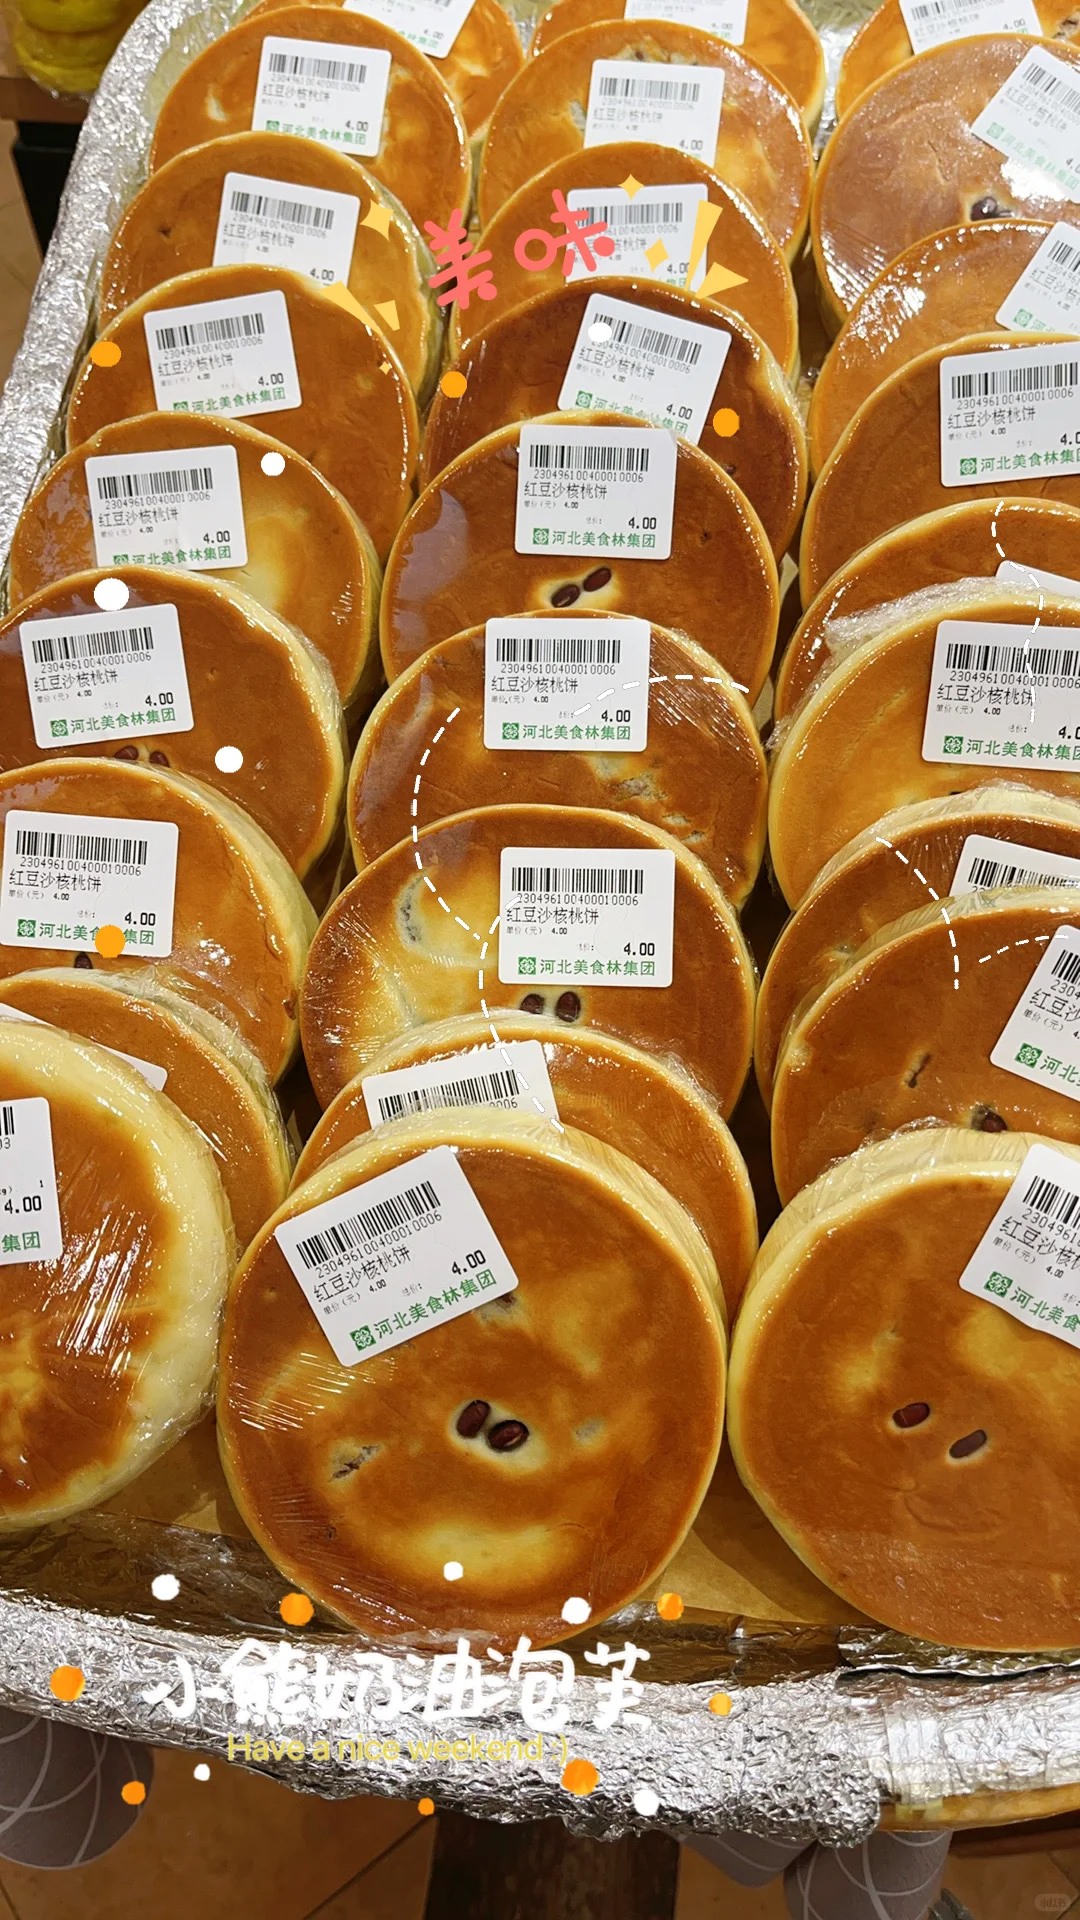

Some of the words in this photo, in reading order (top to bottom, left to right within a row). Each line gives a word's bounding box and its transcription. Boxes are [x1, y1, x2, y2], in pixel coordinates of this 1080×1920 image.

[345, 120, 369, 133] 4.00
[679, 139, 704, 151] 4.00
[310, 268, 334, 281] 4.00
[258, 373, 284, 387] 4.00
[192, 387, 286, 413] 河北美食林集团
[666, 404, 693, 420] 4.00
[534, 469, 644, 482] 230496100400010006
[524, 481, 608, 500] 红豆沙核桃饼
[139, 526, 154, 534] 4.00
[628, 517, 657, 529] 4.00
[203, 530, 230, 544] 4.00
[552, 530, 656, 548] 河北美食林集团
[132, 545, 231, 565] 河北美食林集团
[501, 663, 616, 675] 230496100400010006
[34, 668, 118, 692] 红豆沙核桃饼
[491, 676, 578, 693] 红豆沙核桃饼
[77, 690, 92, 698] 4.00
[145, 692, 174, 706] 4.00
[601, 709, 631, 722] 4.00
[983, 707, 1001, 715] 4.00
[71, 708, 176, 733] 河北美食林集团
[522, 724, 631, 740] 河北美食林集团
[20, 856, 141, 876] 230496100400010006
[9, 869, 101, 893] 红豆沙核桃饼
[53, 893, 69, 901] 4.00
[125, 912, 156, 926] 4.00
[506, 906, 599, 925] 红豆沙核桃饼
[551, 927, 567, 935] 4.00
[624, 942, 655, 956] 4.00
[540, 959, 655, 976] 河北美食林集团
[1040, 1055, 1080, 1087] 河北
[4, 1195, 42, 1215] 4.00
[314, 1210, 442, 1279] 230496100400010006
[451, 1249, 486, 1275] 4.00
[313, 1245, 411, 1303] 红豆沙核桃饼
[1046, 1265, 1064, 1279] 4.00
[369, 1279, 387, 1293] 4.00
[373, 1268, 497, 1338] 河北美食林集团
